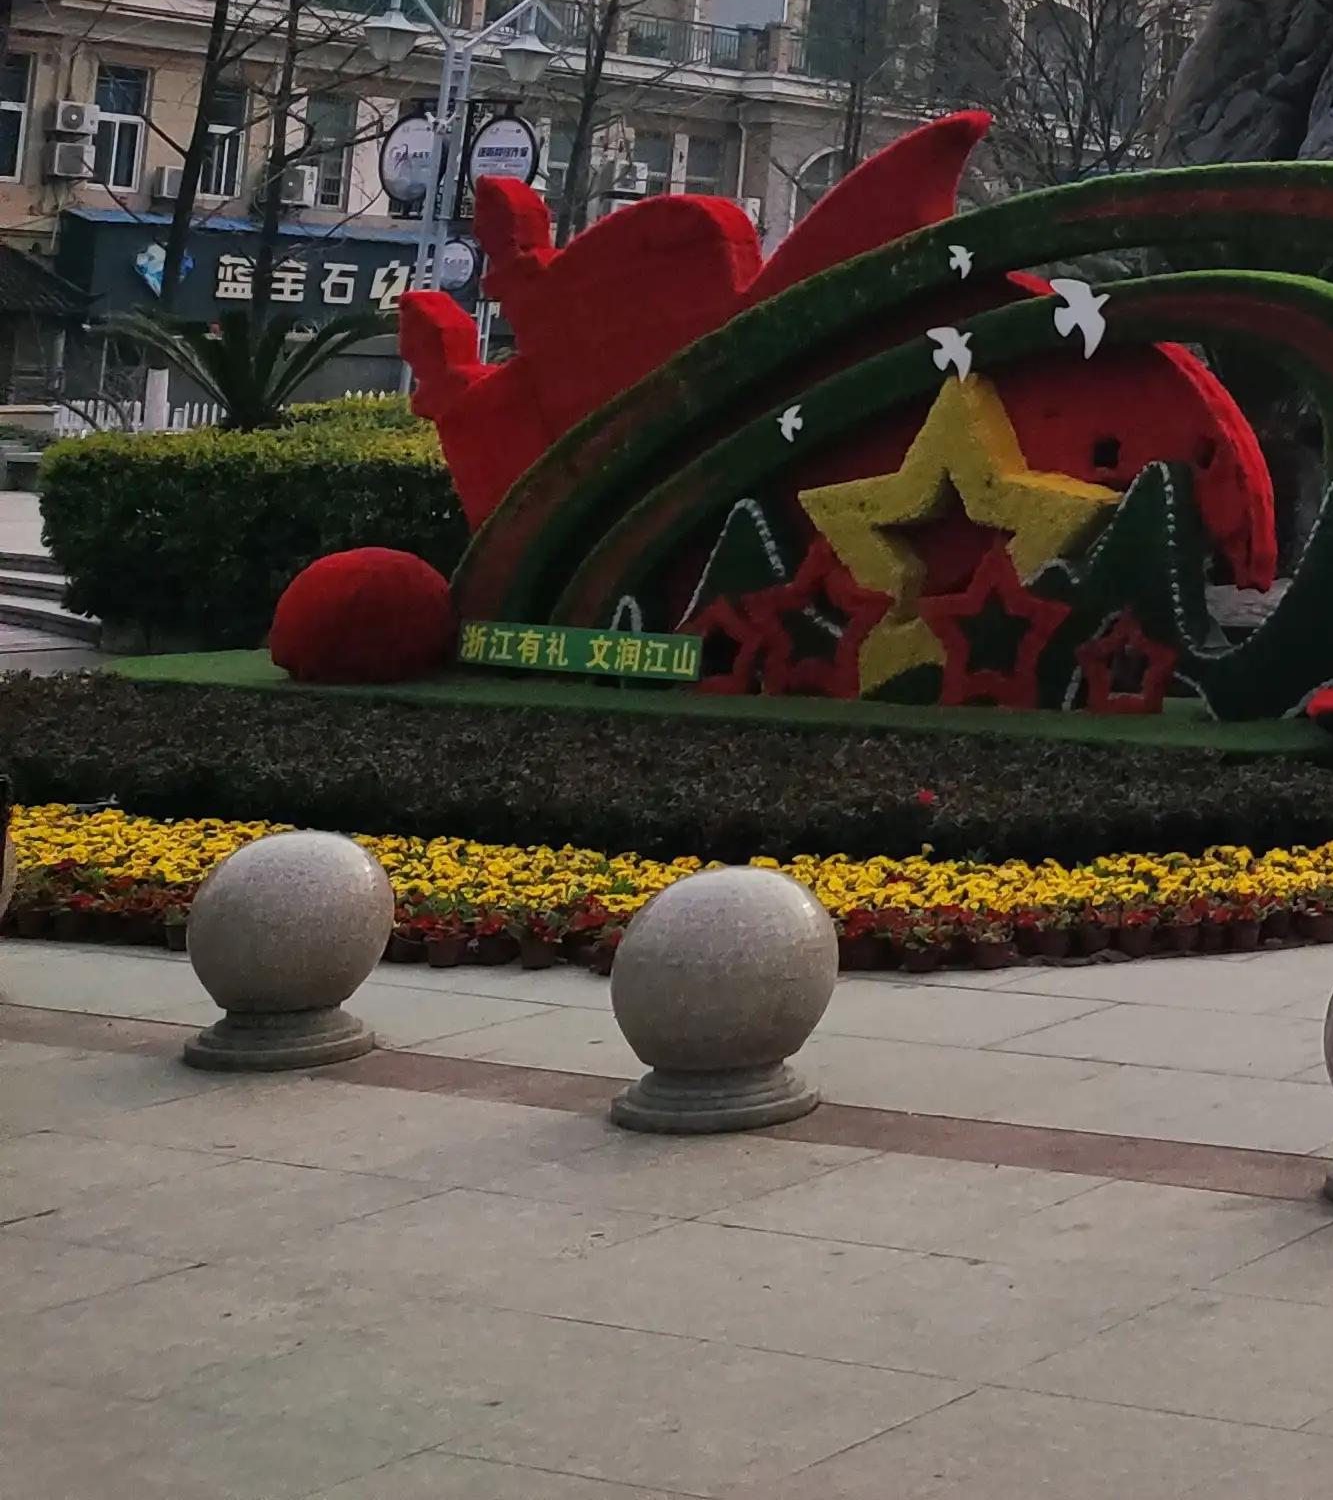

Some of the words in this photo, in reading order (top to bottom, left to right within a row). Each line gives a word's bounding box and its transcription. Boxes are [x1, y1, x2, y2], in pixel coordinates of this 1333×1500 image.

[460, 623, 568, 667] 浙江有礼
[585, 634, 697, 676] 文润江山
